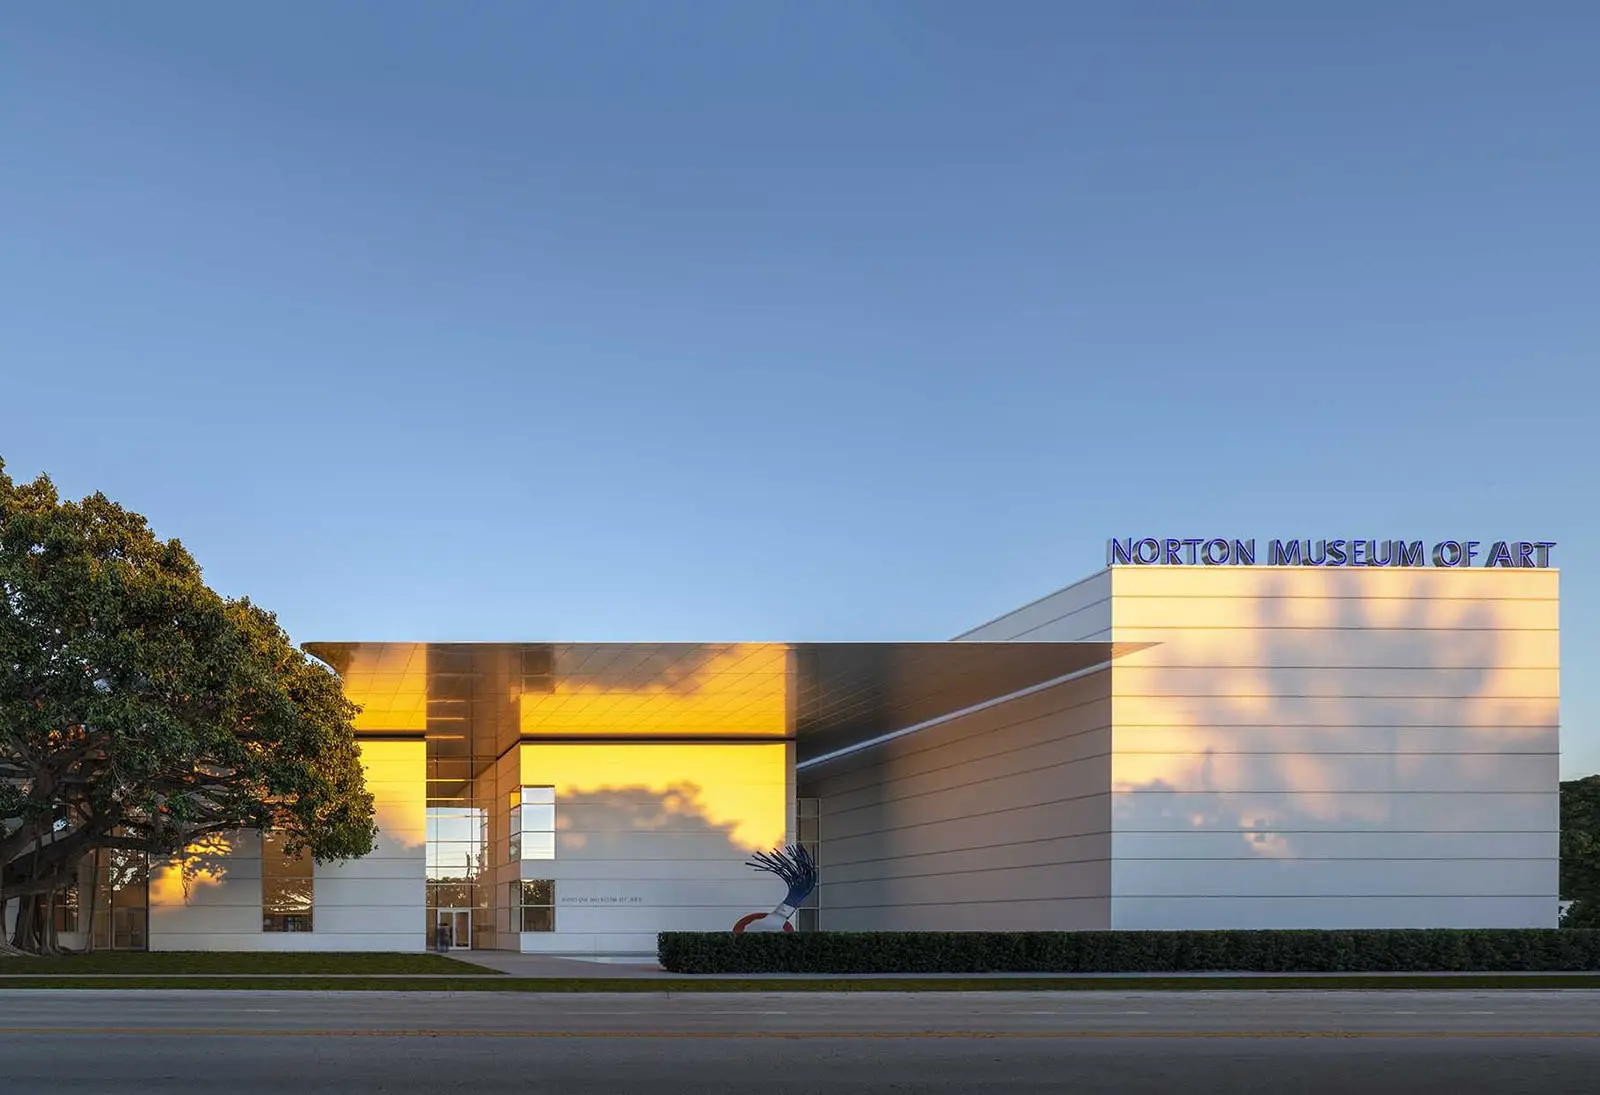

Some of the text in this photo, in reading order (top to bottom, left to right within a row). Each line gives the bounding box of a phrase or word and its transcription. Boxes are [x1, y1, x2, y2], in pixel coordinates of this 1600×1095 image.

[1109, 537, 1557, 568] NORTON MUSEUM OF ART
